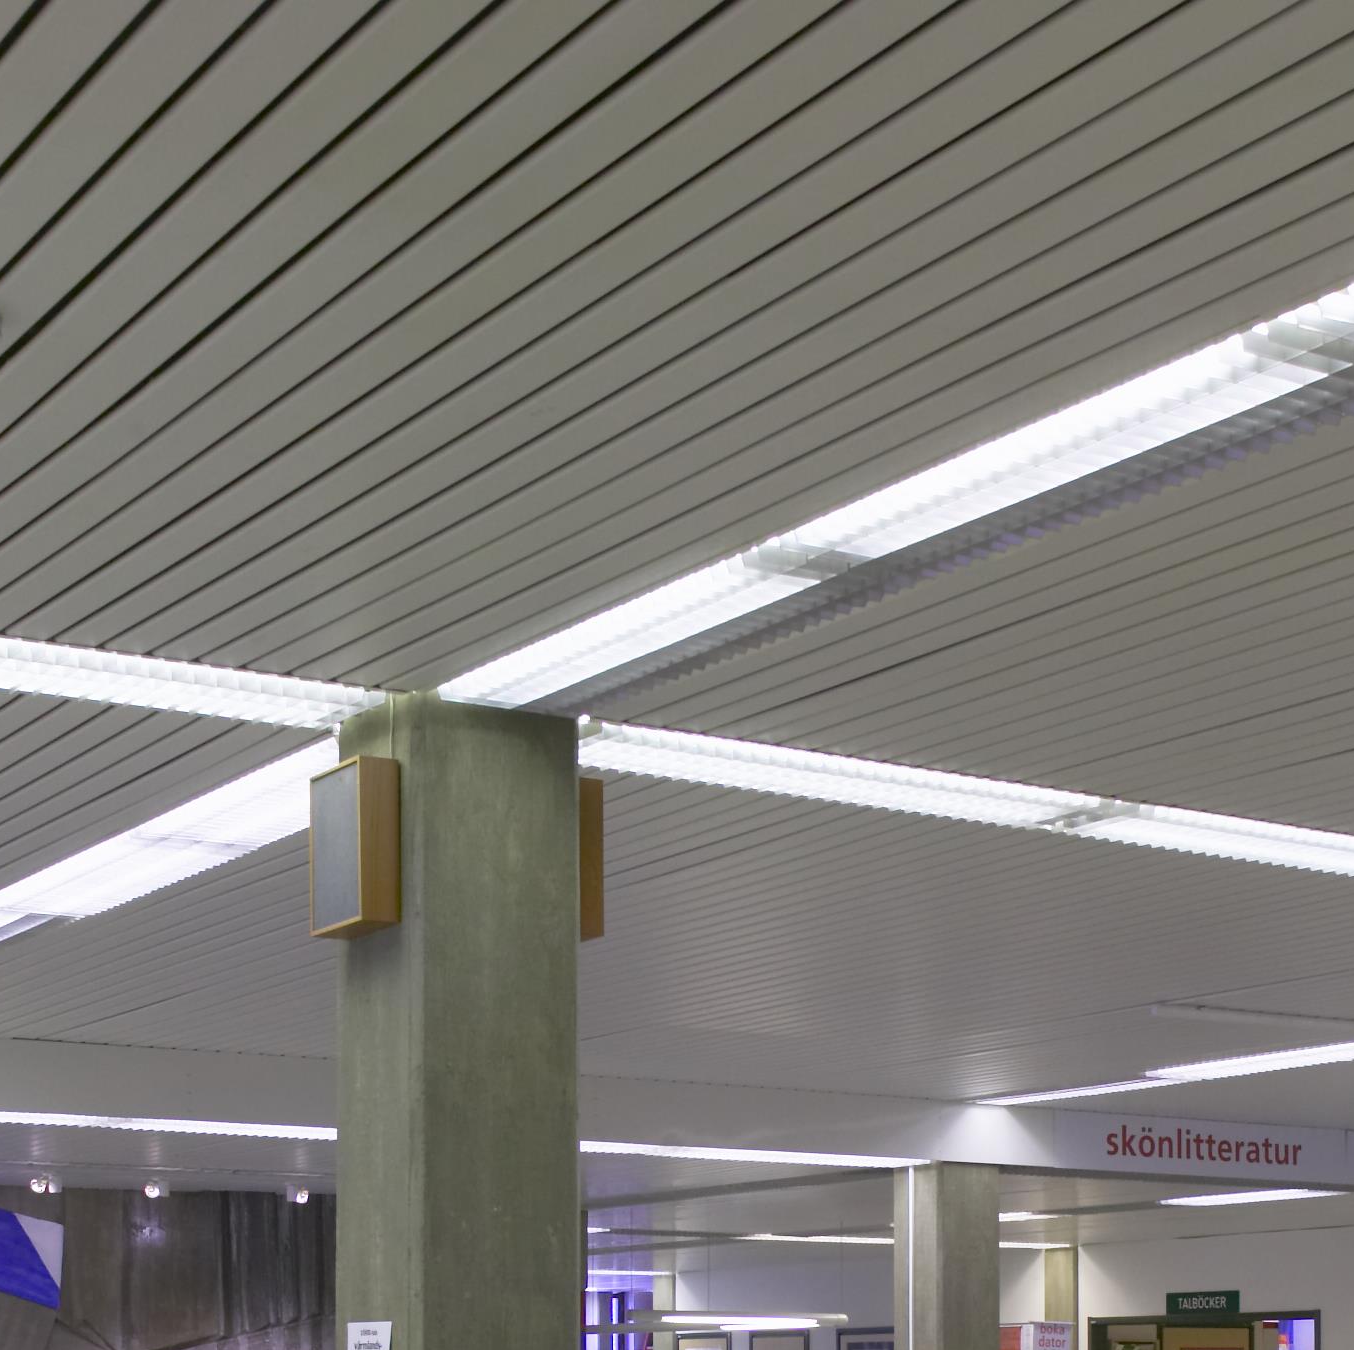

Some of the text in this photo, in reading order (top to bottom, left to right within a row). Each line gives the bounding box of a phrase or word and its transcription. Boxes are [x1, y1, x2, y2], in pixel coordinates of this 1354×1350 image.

[1106, 1125, 1302, 1166] skönlitteratur
[1178, 1295, 1227, 1310] TALBÖCKER
[1040, 1325, 1066, 1335] boka
[1038, 1336, 1067, 1348] dator
